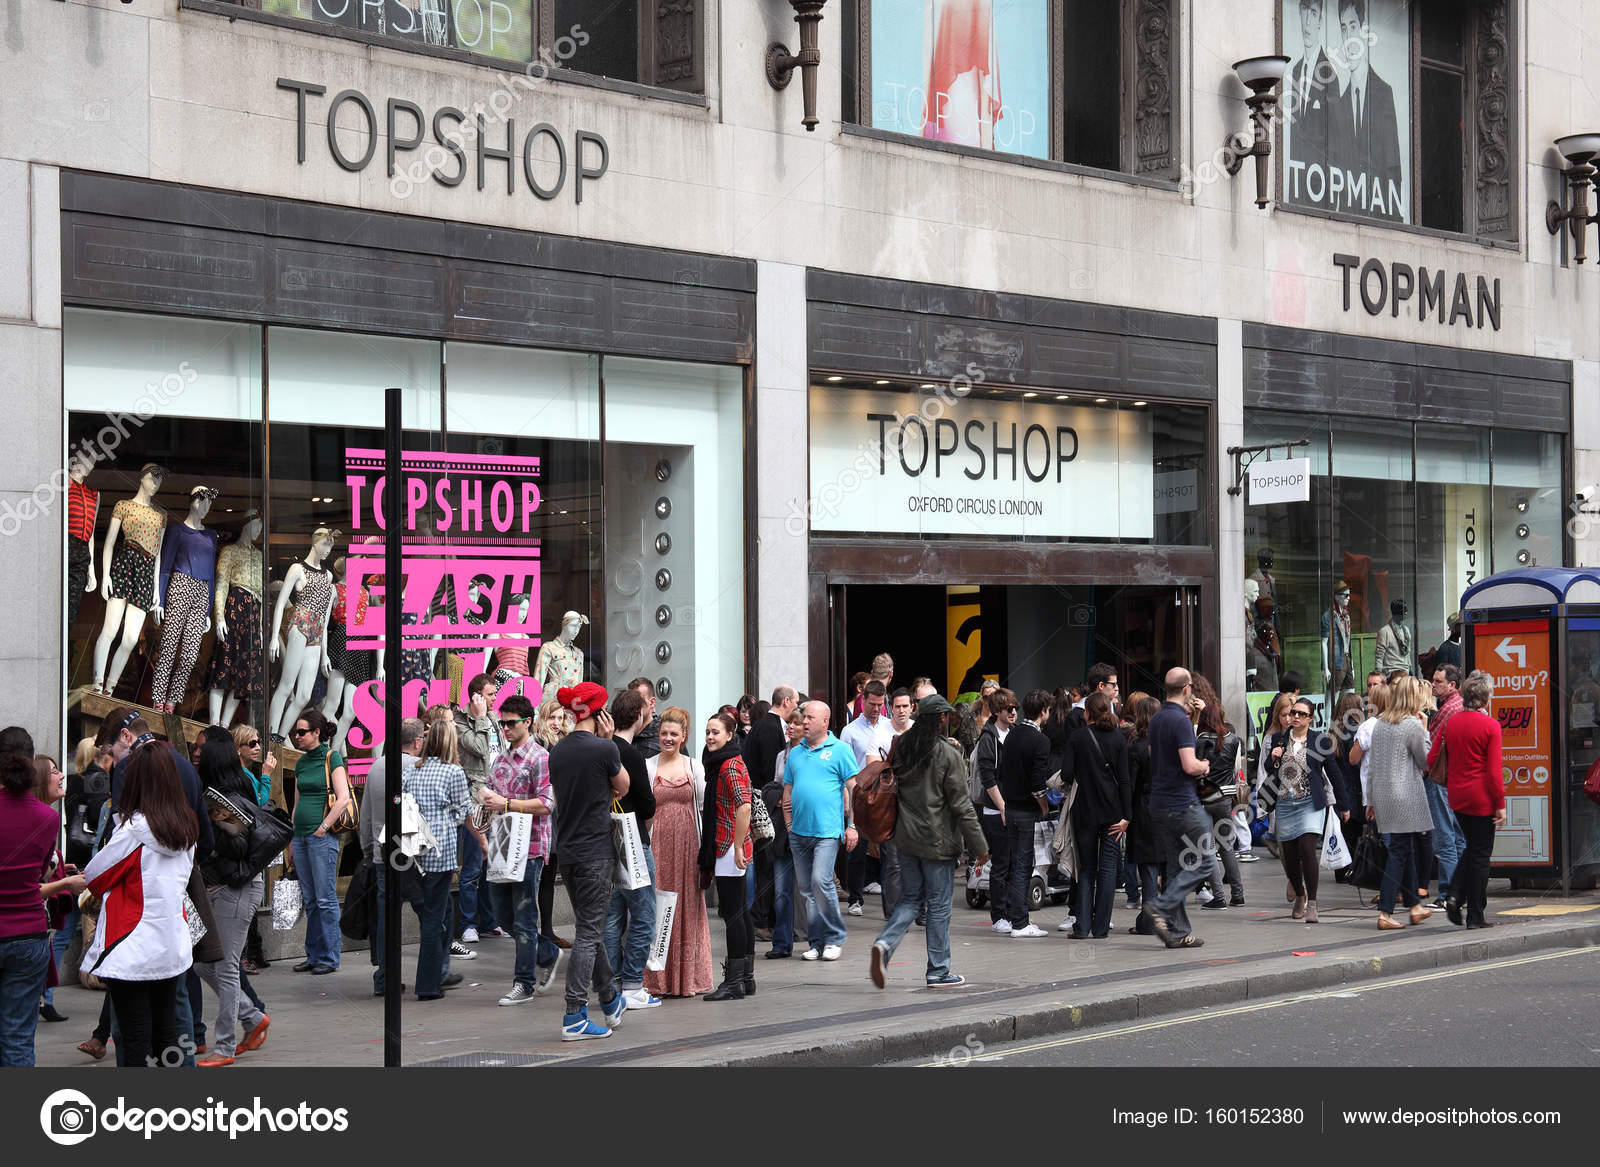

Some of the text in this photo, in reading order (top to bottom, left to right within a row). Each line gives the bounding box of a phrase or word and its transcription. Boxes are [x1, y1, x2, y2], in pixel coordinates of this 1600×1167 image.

[277, 77, 609, 204] TOPSHOP
[1288, 160, 1404, 219] TOPMAN
[1333, 252, 1501, 331] TOPMAN
[866, 413, 1079, 484] TOPSHOP
[908, 496, 1043, 516] OXFORD CIRCUS LONDON
[1252, 474, 1304, 489] TOPSHOP
[1491, 670, 1549, 691] ungry?
[820, 750, 833, 761] 82
[658, 906, 673, 958] TOPMAN.COM
